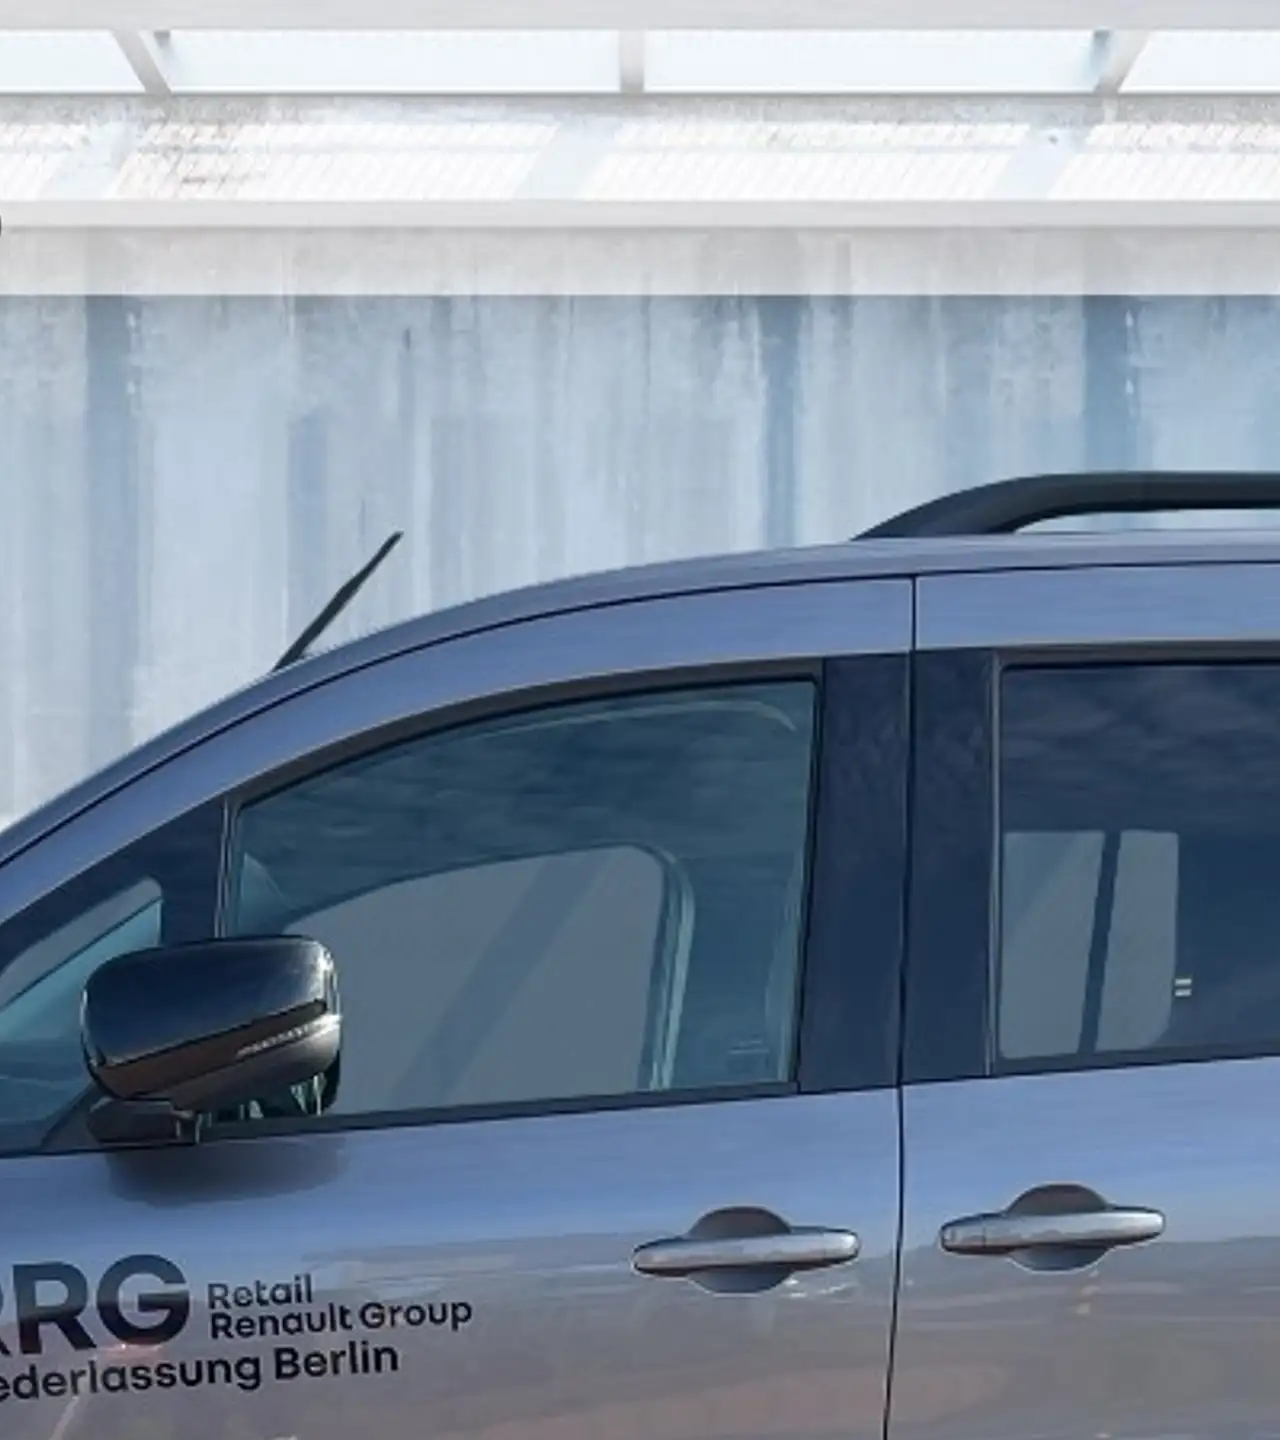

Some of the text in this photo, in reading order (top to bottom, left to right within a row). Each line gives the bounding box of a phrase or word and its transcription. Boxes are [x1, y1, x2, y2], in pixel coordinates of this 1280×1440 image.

[208, 1274, 313, 1309] Retail
[210, 1297, 472, 1339] Renault Group
[274, 1341, 398, 1380] Berlin
